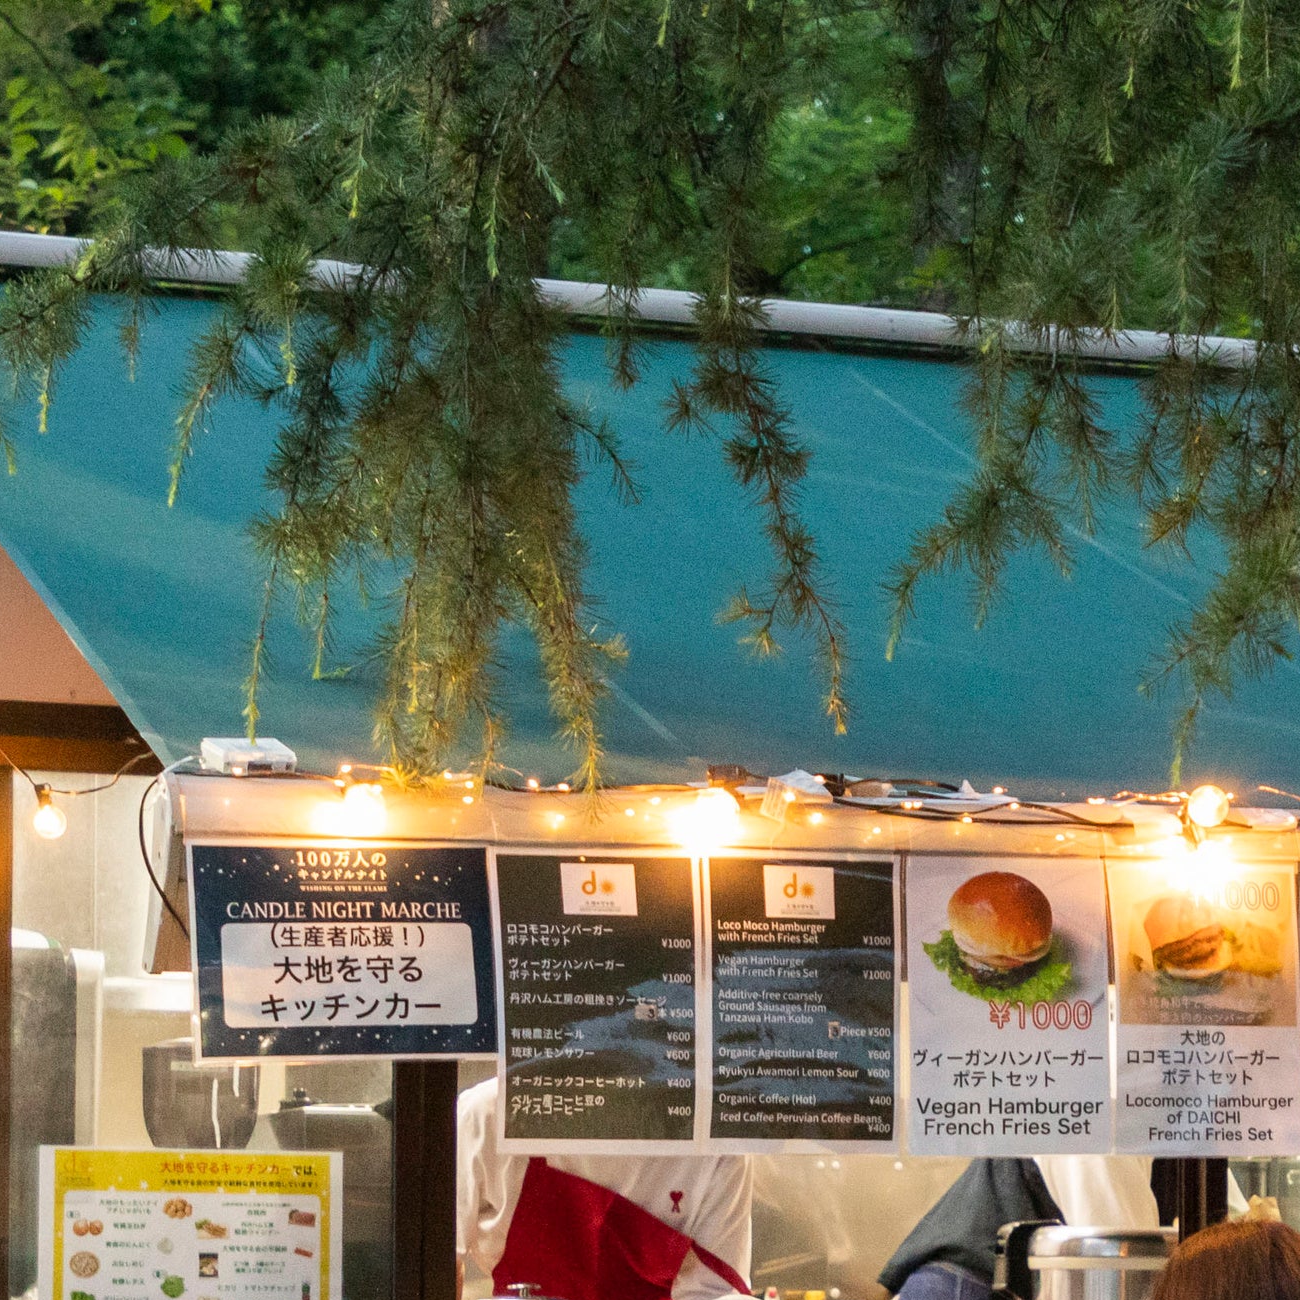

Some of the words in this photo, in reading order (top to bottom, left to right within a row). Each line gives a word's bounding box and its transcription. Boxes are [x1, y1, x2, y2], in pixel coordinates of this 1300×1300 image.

[296, 850, 387, 868] 100万人の
[298, 868, 387, 880] キャンドルナイト
[226, 902, 306, 919] CANDLE
[313, 902, 375, 919] NIGHT
[381, 902, 462, 919] MARCHE
[507, 923, 613, 935] ロコモコハンバーガー
[718, 920, 741, 931] Loco
[743, 921, 769, 931] Moco
[771, 921, 826, 934] Hamburger
[270, 922, 425, 949] （生産者応援！）
[507, 935, 570, 946] ポテトセット
[718, 931, 740, 942] with
[742, 932, 776, 943] French
[778, 932, 801, 944] Fries
[803, 934, 819, 944] Set
[273, 955, 424, 985] 大地を守る
[508, 958, 625, 970] ヴィーガンハンバーガー
[508, 970, 572, 981] ポテトセット
[261, 993, 442, 1022] キッチンカー
[989, 999, 1092, 1030] ¥1000
[511, 1028, 584, 1040] 有機農法ビール
[1180, 1030, 1226, 1046] 大地の
[511, 1047, 594, 1059] 琉球レモンサワー
[718, 1047, 756, 1059] Organic
[758, 1048, 814, 1060] Agricultural
[816, 1049, 838, 1059] Beer
[913, 1049, 1104, 1067] ヴィーガンハンバーガー
[1127, 1050, 1280, 1066] ロコモコハンバーガー
[718, 1066, 754, 1078] Ryukyu
[756, 1067, 800, 1077] Awamori
[802, 1067, 834, 1077] Lemon
[836, 1067, 858, 1078] Sour
[953, 1070, 1056, 1088] ポテトセット
[1162, 1069, 1253, 1085] ポテトセット
[512, 1077, 646, 1088] オーガニックコーヒーホット
[719, 1094, 757, 1105] Organic
[759, 1093, 789, 1104] Coffee
[792, 1094, 817, 1106] (Hot)
[1126, 1094, 1201, 1108] Locomoco
[1207, 1095, 1294, 1110] Hamburger
[511, 1104, 584, 1115] アイスコーヒー
[916, 1098, 981, 1118] Vegan
[988, 1098, 1104, 1118] Hamburger
[720, 1111, 741, 1122] Iced
[743, 1112, 774, 1122] Coffee
[776, 1113, 819, 1123] Peruvian
[821, 1114, 852, 1124] Coffee
[853, 1115, 882, 1125] Beans
[1167, 1111, 1183, 1125] of
[1188, 1111, 1241, 1125] DAICHI
[924, 1118, 995, 1135] French
[1002, 1118, 1050, 1135] Fries
[1058, 1118, 1091, 1135] Set
[1150, 1127, 1200, 1141] French
[1205, 1127, 1242, 1141] Fries
[1248, 1127, 1273, 1141] Set
[160, 1161, 318, 1176] 大地を守るキッチンカーでは、
